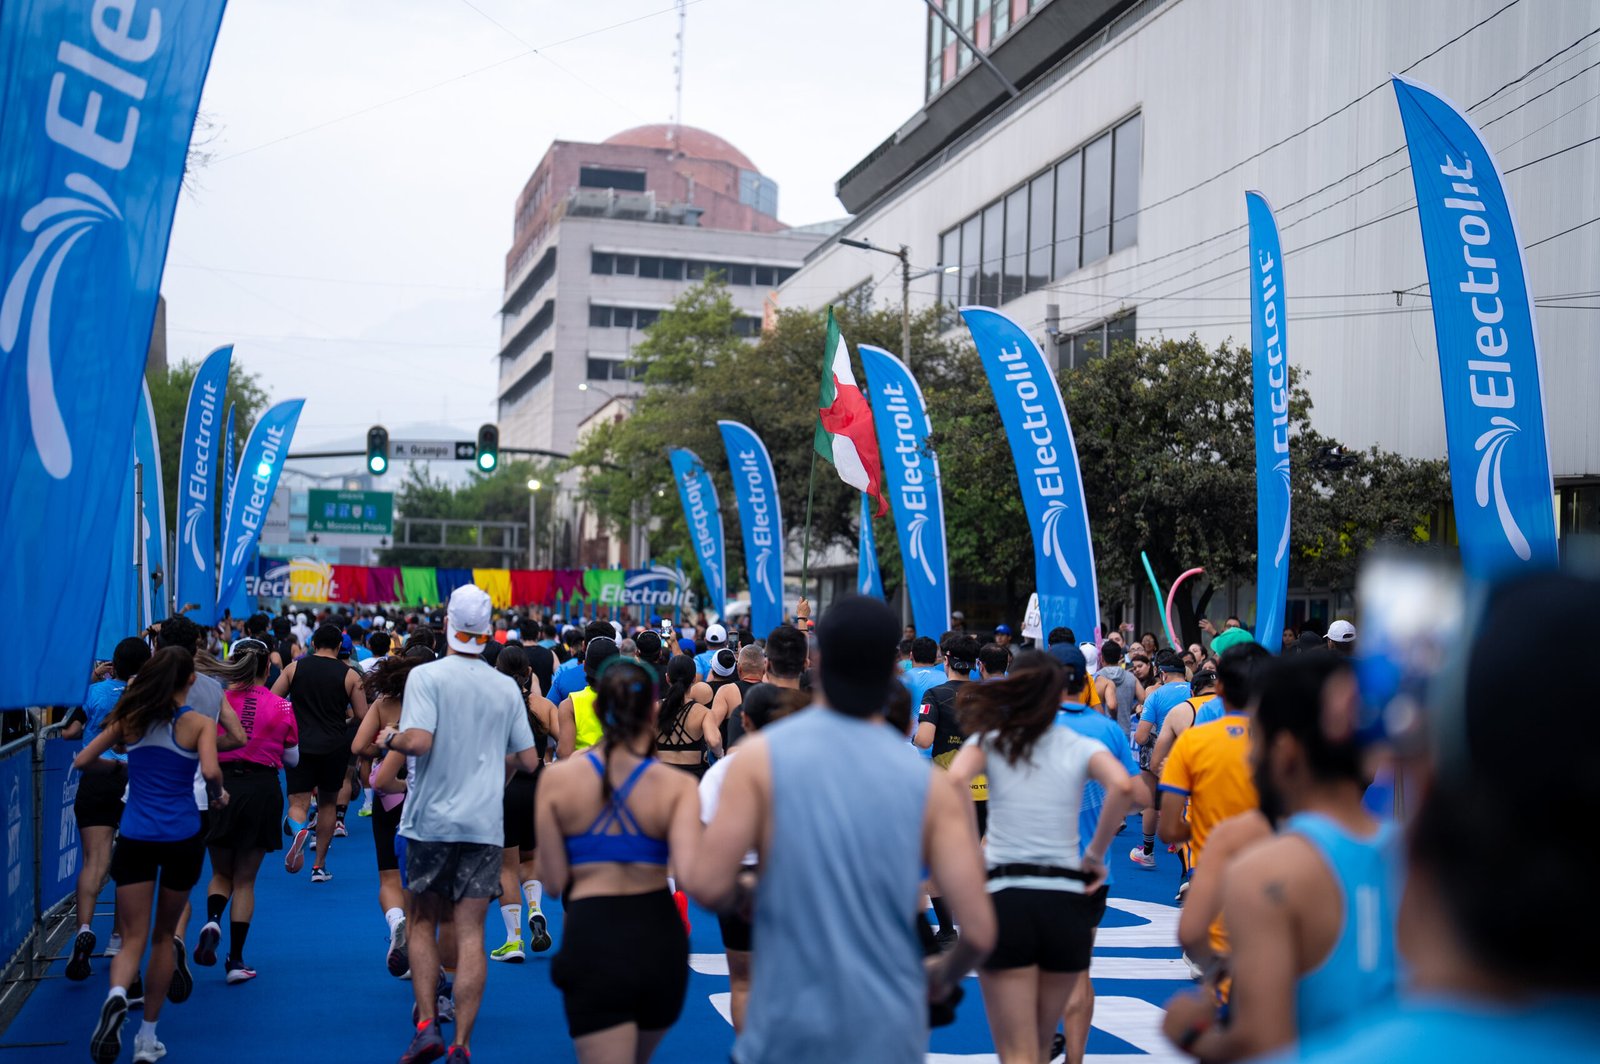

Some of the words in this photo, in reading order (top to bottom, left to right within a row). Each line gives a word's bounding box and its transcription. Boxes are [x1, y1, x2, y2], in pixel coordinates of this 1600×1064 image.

[1440, 151, 1516, 409] Electrolit
[188, 380, 217, 502] Electrolit
[410, 444, 449, 458] Ocampo
[883, 382, 927, 511] Electrolit
[998, 342, 1064, 497] Electrolit
[739, 449, 772, 546] Electrolit
[600, 583, 696, 607] Electrolit
